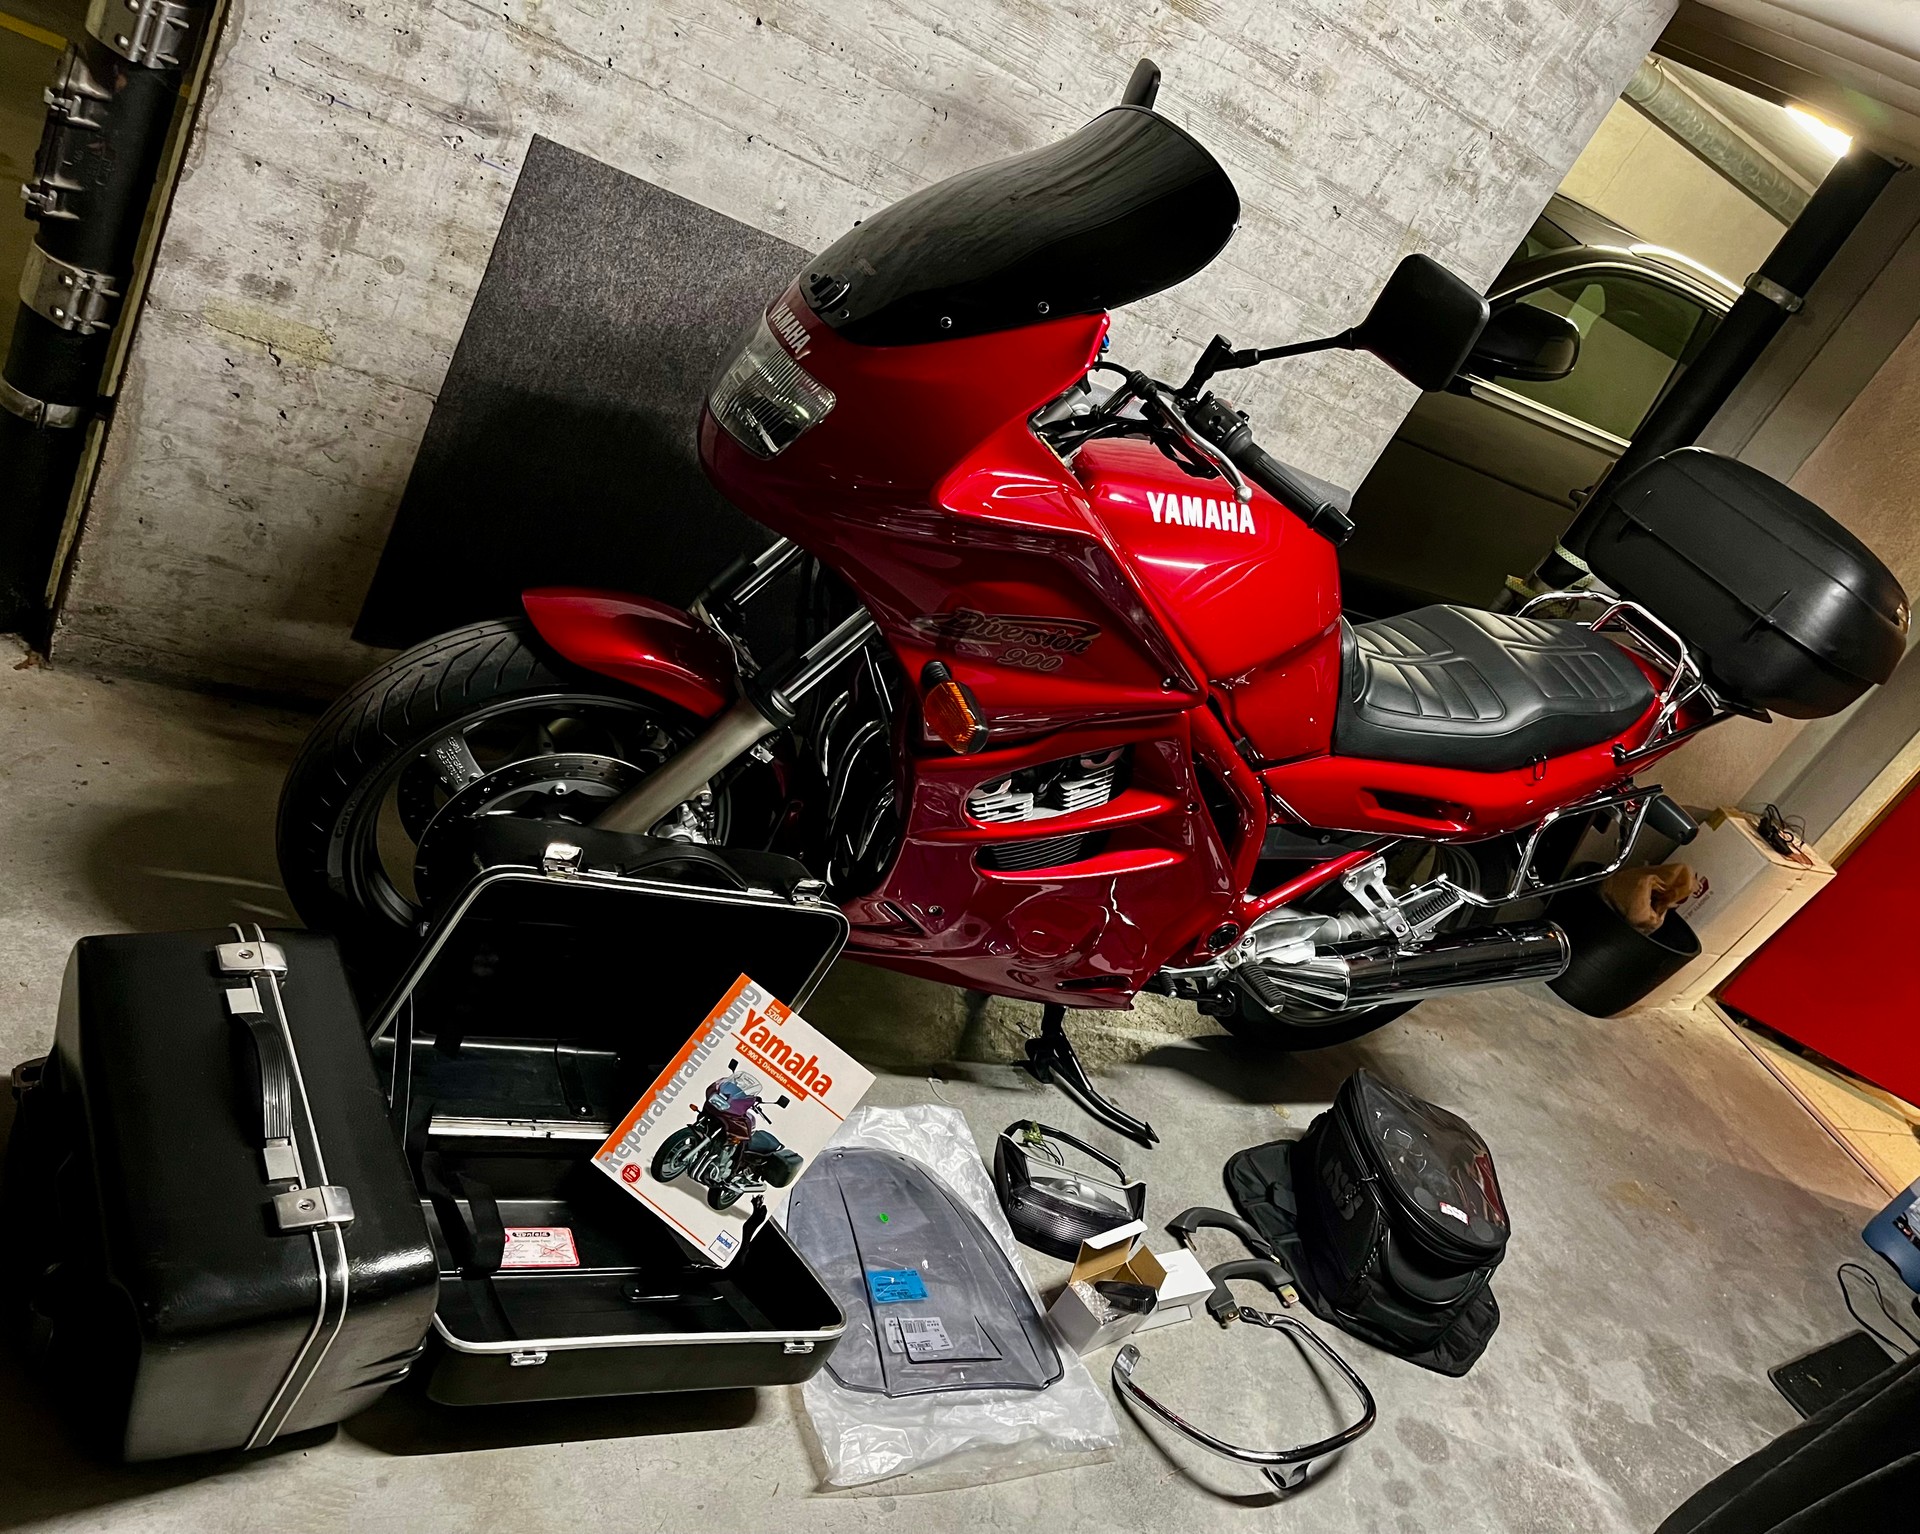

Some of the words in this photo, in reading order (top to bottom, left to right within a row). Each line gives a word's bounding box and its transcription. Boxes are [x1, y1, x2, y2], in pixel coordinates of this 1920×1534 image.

[770, 302, 811, 354] YAMAHA
[1146, 491, 1256, 535] YAMAHA
[947, 607, 1092, 653] Diversion
[997, 648, 1063, 671] 900
[740, 1008, 832, 1097] Yamaha
[740, 1043, 748, 1052] XJ
[748, 1050, 758, 1060] 900
[762, 1061, 788, 1084] Diversion
[599, 984, 762, 1173] Reparaturanleitung
